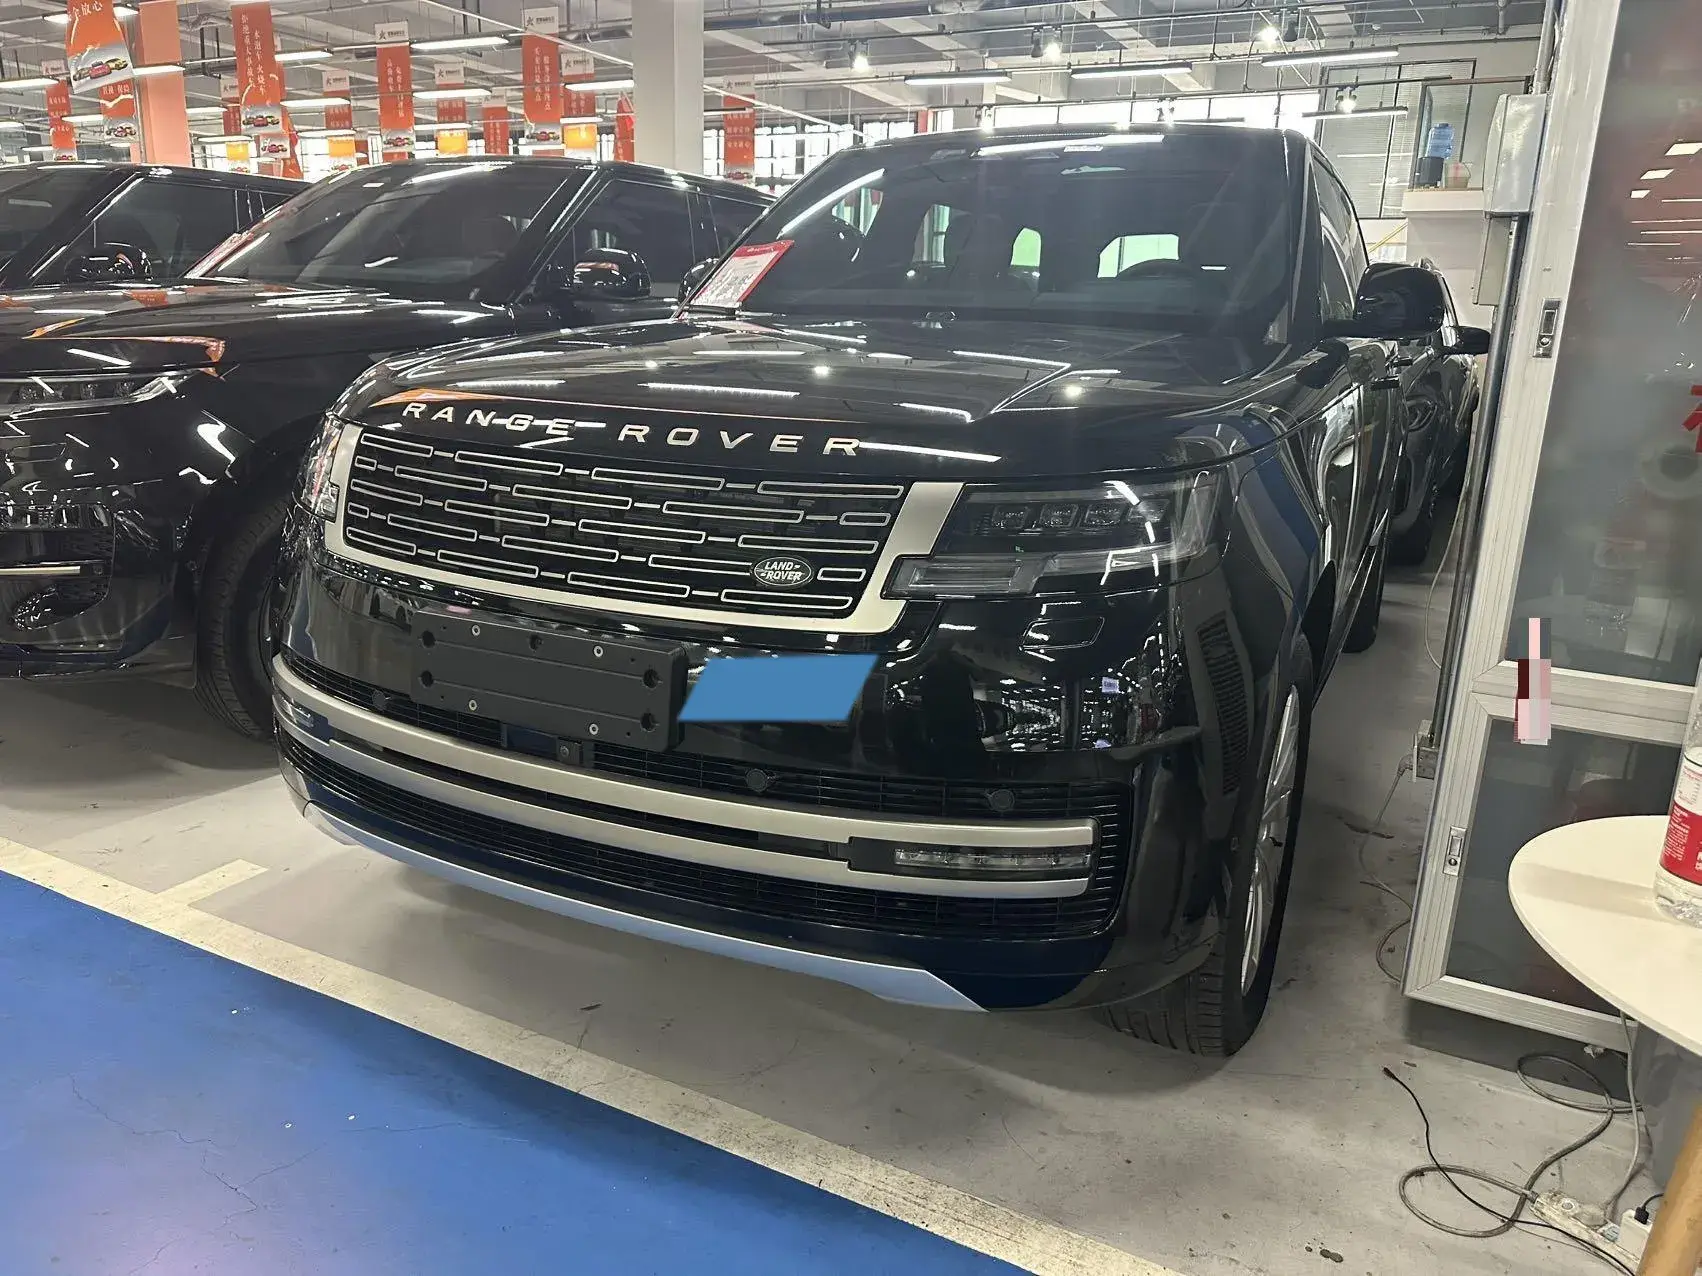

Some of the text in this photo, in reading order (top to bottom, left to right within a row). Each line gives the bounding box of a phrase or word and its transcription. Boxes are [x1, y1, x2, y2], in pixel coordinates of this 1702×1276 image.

[402, 402, 862, 456] RANGE ROVER
[765, 561, 794, 571] LAND
[765, 570, 803, 581] ROVER
